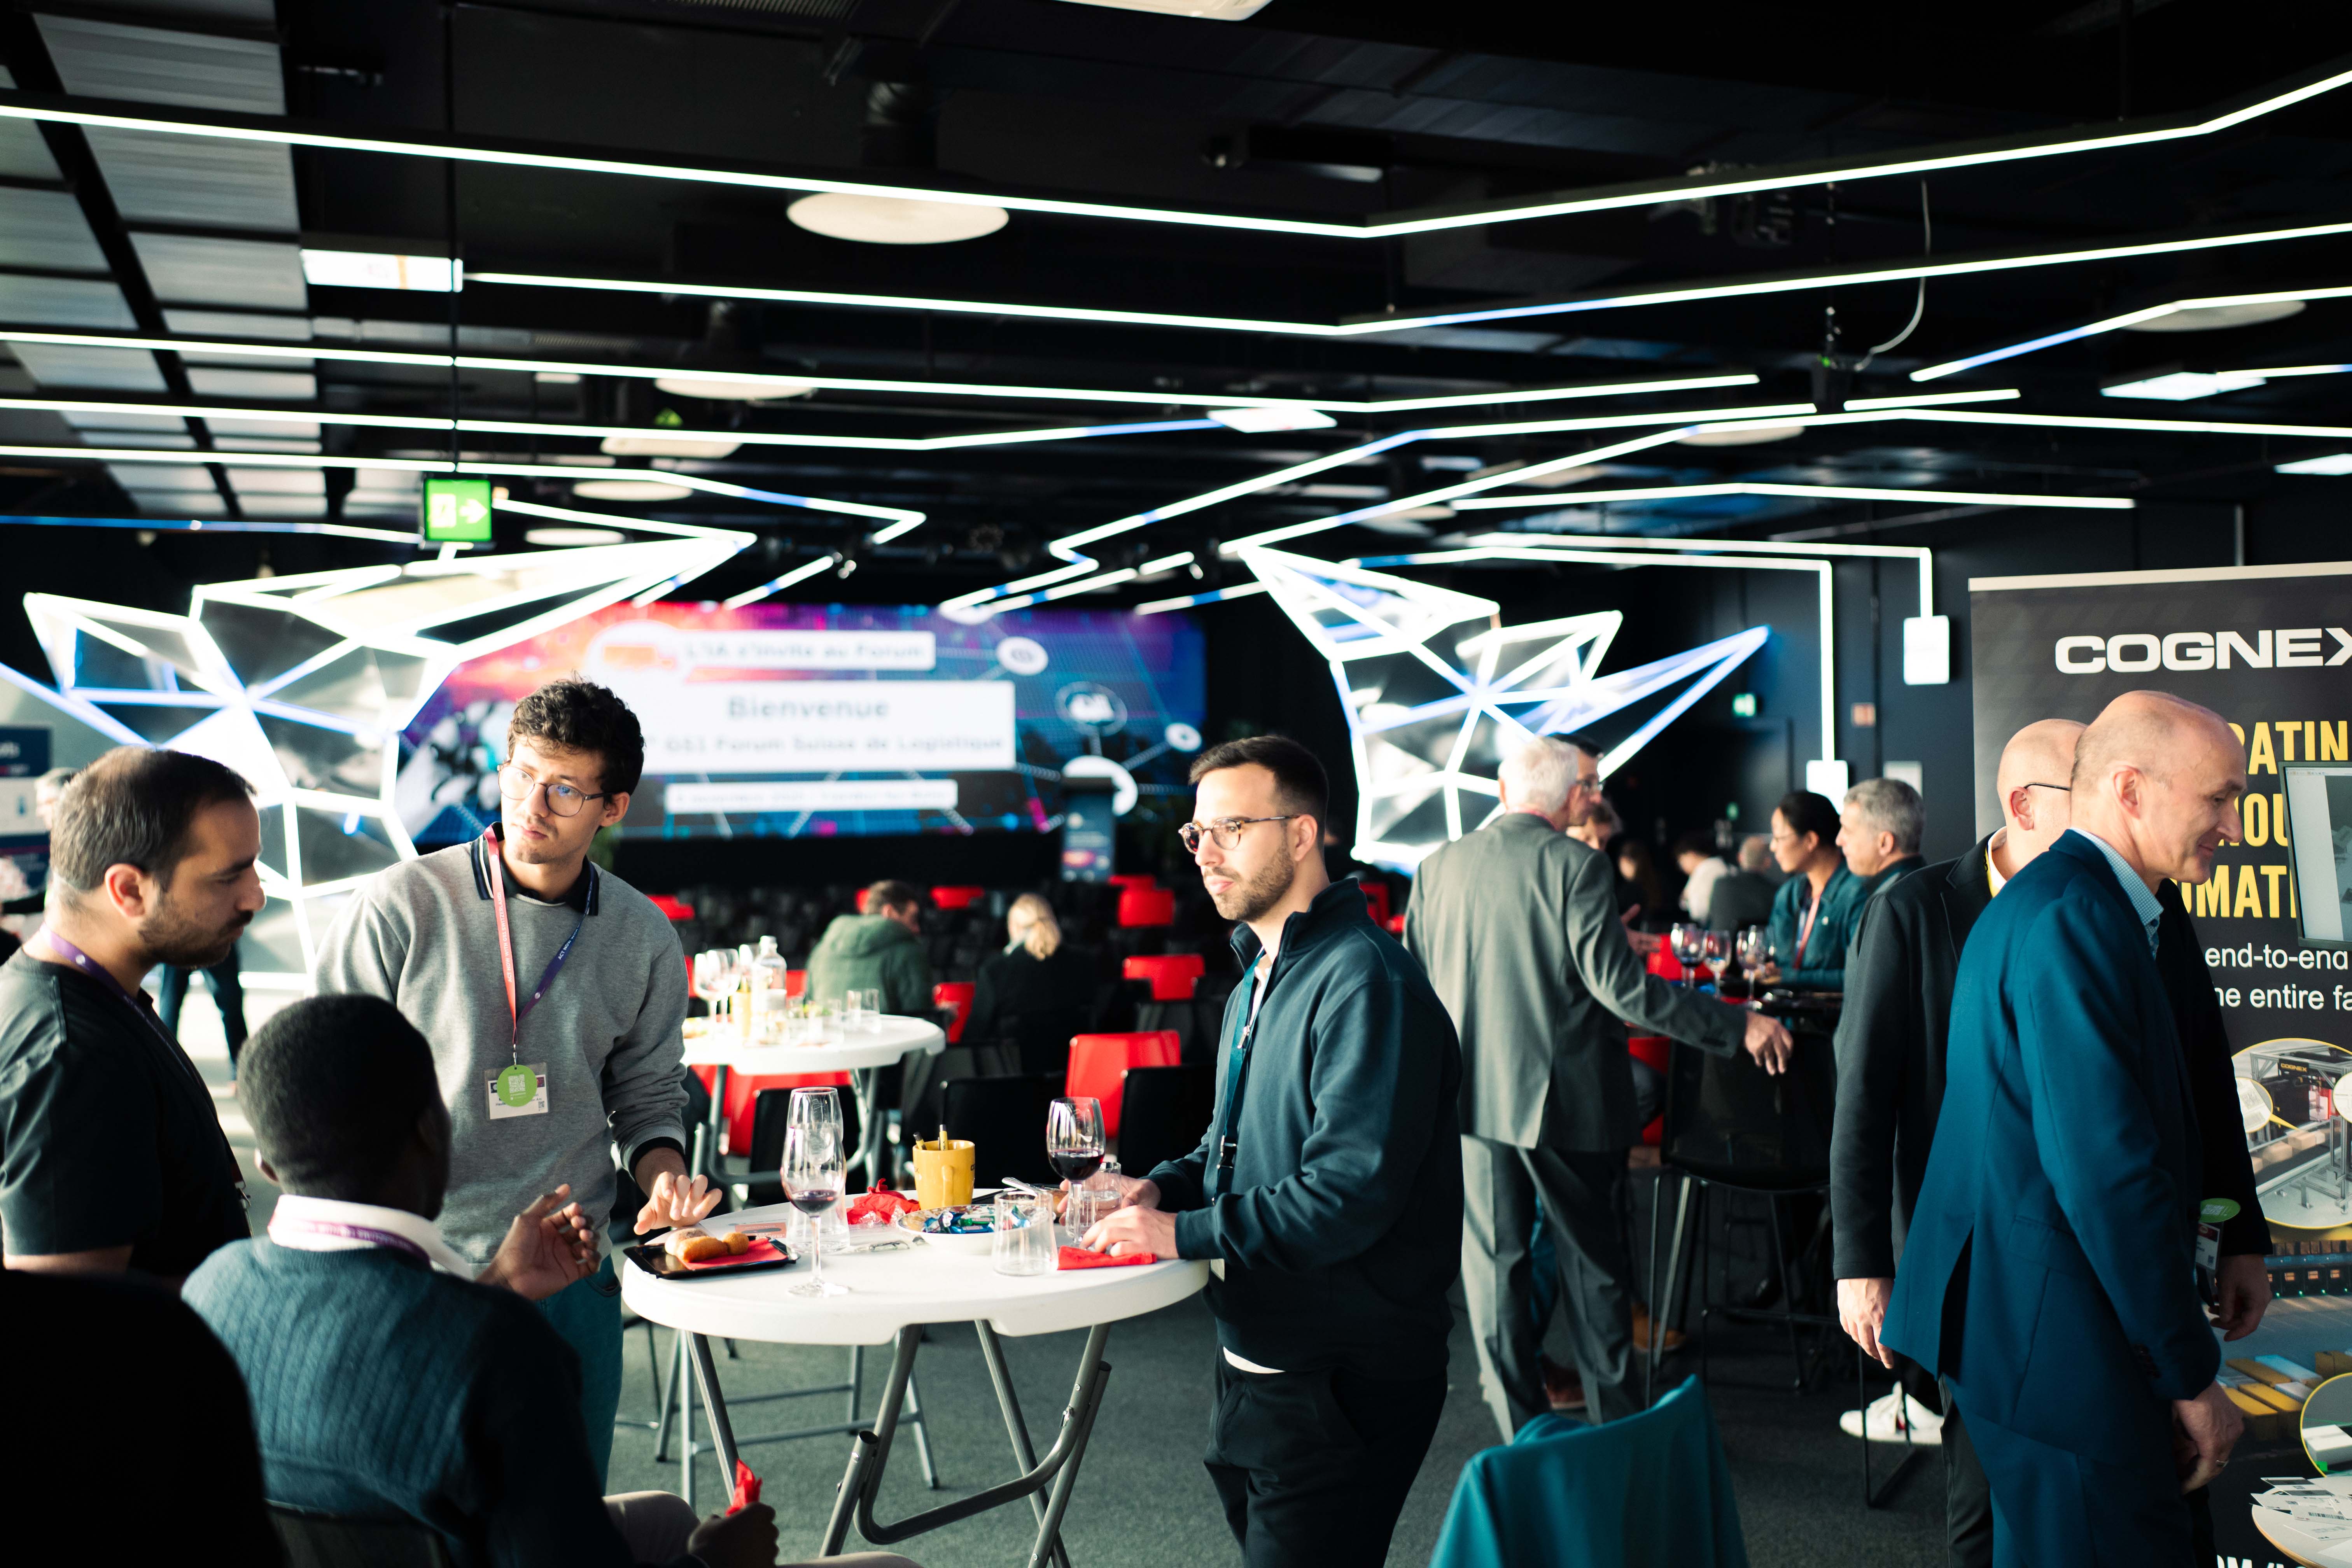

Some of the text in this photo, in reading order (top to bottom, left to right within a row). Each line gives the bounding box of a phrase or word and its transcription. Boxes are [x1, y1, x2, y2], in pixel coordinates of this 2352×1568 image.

[857, 643, 923, 658] Forum
[2055, 627, 2352, 674] COGNEX
[728, 696, 889, 719] Bienvenue
[716, 737, 783, 752] Forum
[794, 736, 854, 752] Suisse
[866, 736, 888, 750] de
[899, 735, 1003, 754] Logistique
[2249, 984, 2324, 1010] entire
[2280, 1063, 2307, 1073] COGNEX
